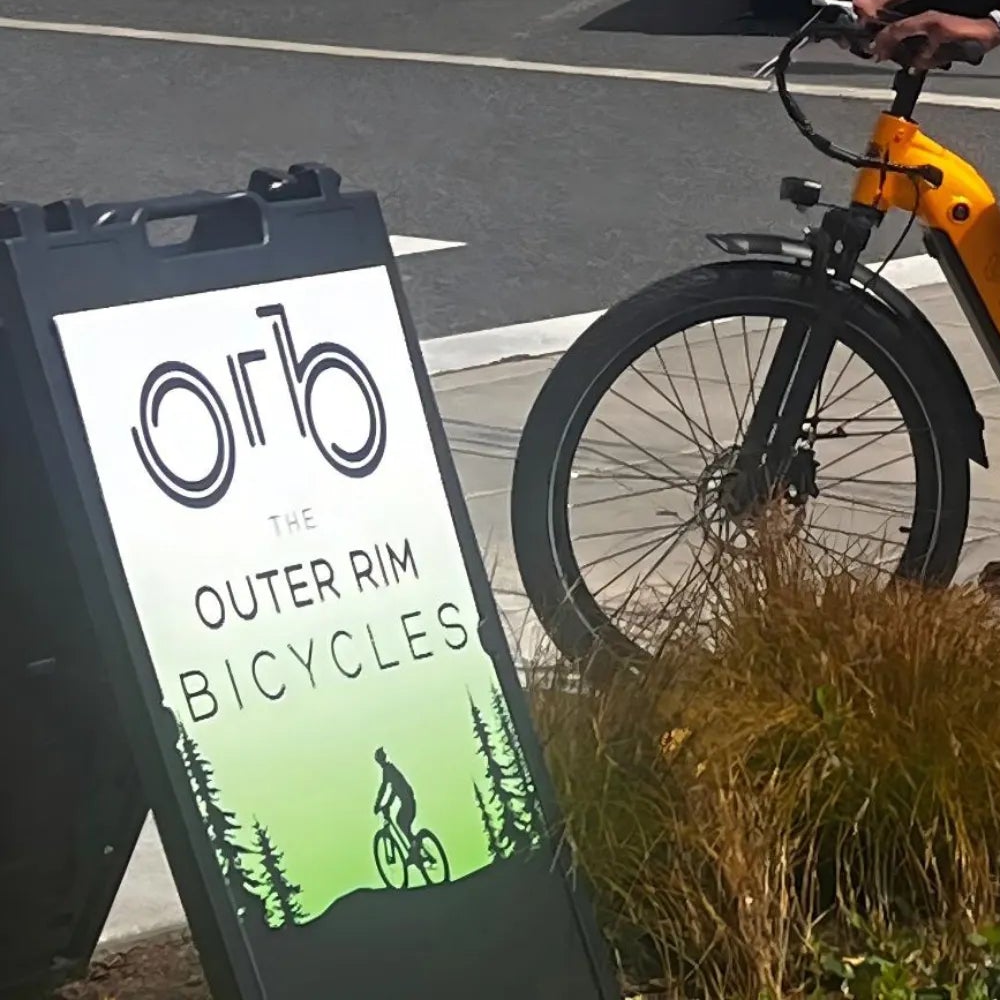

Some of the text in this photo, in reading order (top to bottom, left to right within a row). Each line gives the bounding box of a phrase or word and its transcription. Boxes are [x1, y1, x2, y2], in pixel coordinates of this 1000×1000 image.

[268, 508, 318, 538] THE
[195, 538, 420, 630] OUTER RIM
[179, 602, 469, 723] BICYCLES
